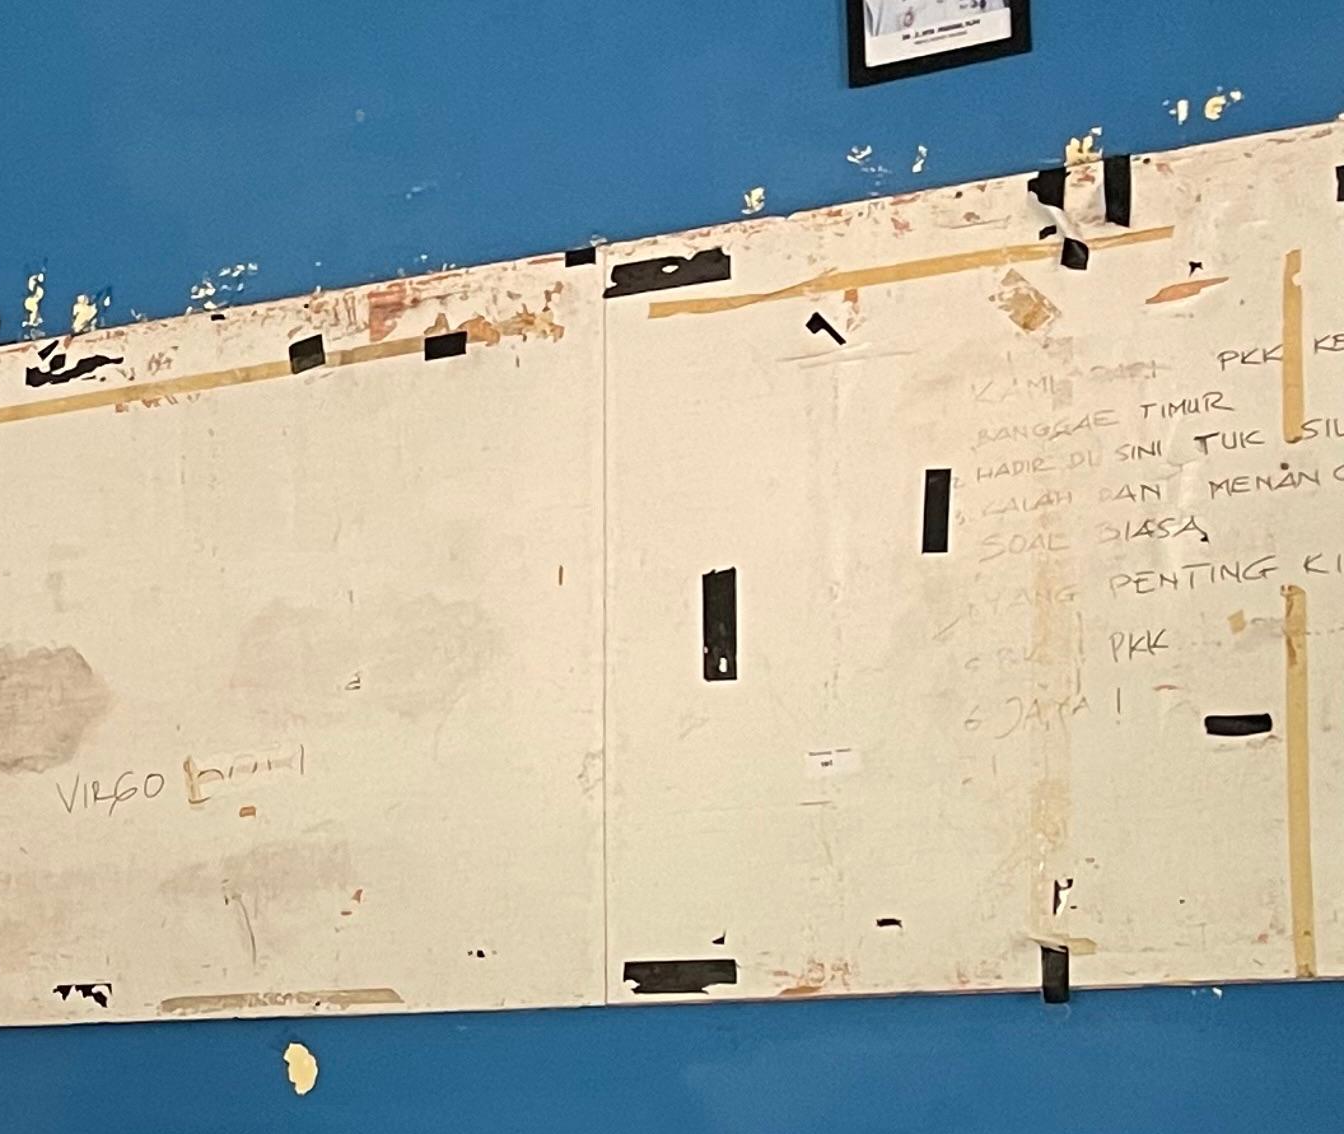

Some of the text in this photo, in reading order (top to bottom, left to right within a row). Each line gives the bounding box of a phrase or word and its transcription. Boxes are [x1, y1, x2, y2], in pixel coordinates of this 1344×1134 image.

[1217, 344, 1284, 371] PKK
[1140, 391, 1234, 421] TIMUR
[976, 457, 1057, 482] HADIR
[1115, 440, 1163, 462] SINI
[1193, 430, 1265, 456] TUK
[1109, 555, 1279, 599] PENTING
[1109, 628, 1169, 663] PKK
[56, 770, 165, 816] VIRGO
